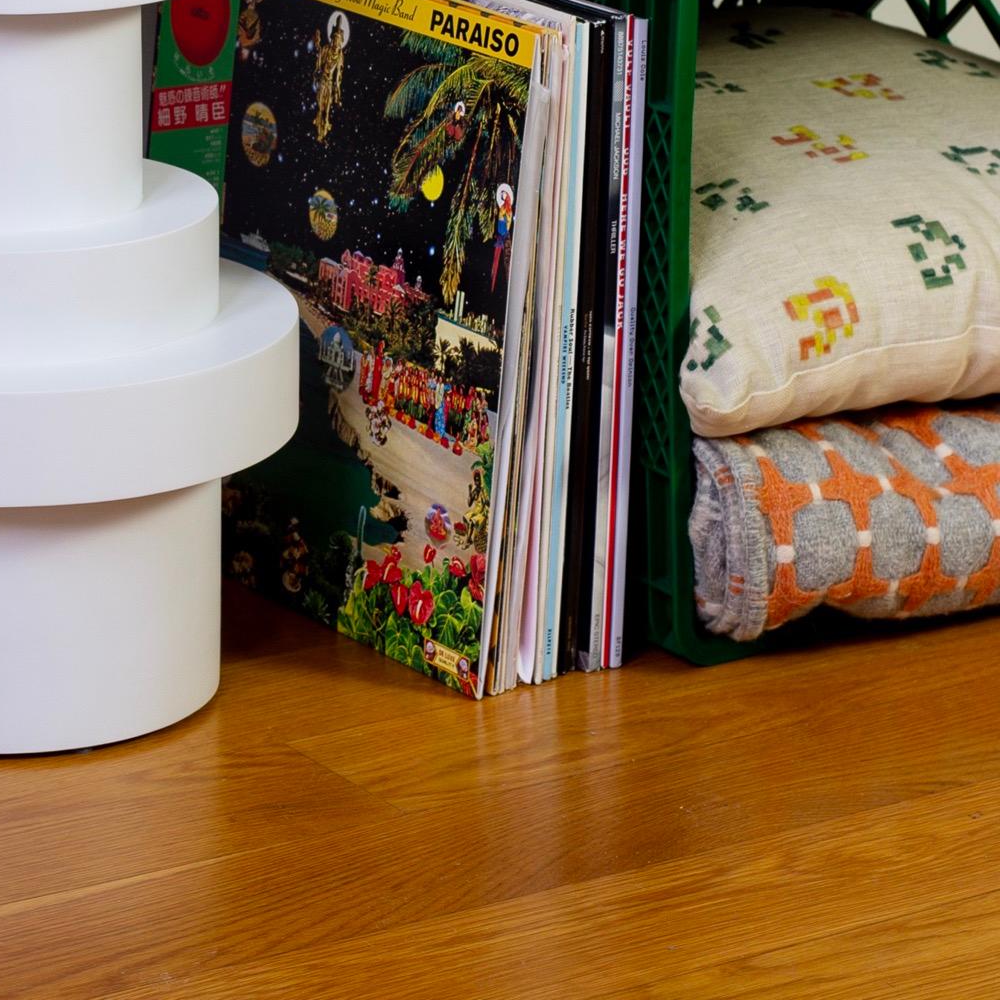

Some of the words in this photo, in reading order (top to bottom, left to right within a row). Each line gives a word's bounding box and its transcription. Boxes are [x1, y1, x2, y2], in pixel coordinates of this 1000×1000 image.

[391, 0, 418, 22] Band
[430, 9, 519, 57] PARAISO
[614, 112, 622, 144] MICHAEL
